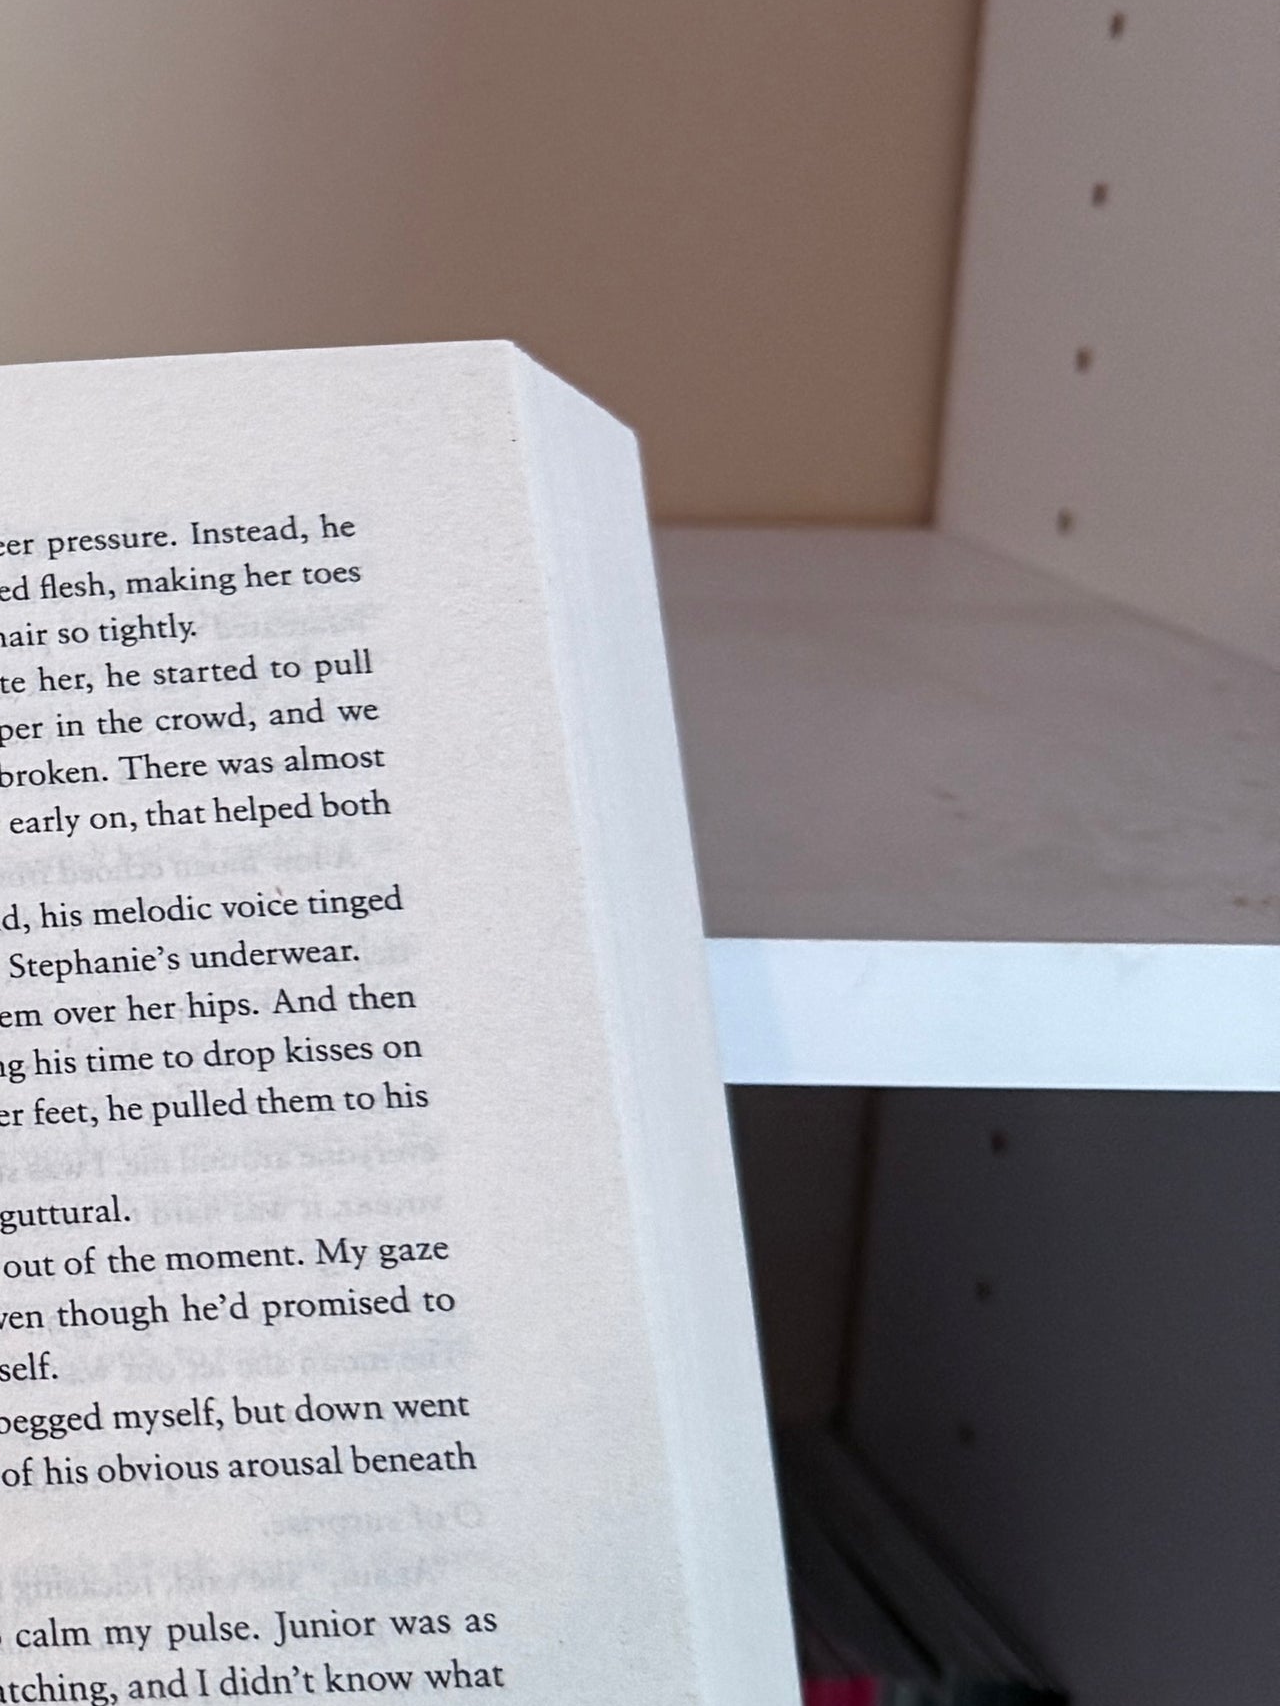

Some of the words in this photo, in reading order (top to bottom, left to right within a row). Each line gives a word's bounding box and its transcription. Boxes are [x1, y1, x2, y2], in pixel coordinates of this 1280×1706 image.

[46, 530, 178, 562] pressure.
[189, 513, 310, 546] Instead,
[318, 512, 357, 540] he
[116, 752, 210, 782] There
[215, 755, 276, 777] was
[282, 743, 387, 774] almost
[2, 1255, 57, 1280] out
[62, 1244, 97, 1277] of
[106, 1243, 158, 1275] the
[163, 1244, 306, 1272] moment.
[314, 1236, 369, 1272] My
[377, 1240, 450, 1271] gaze
[14, 1615, 93, 1650] calm
[103, 1623, 154, 1653] my
[165, 1609, 261, 1653] pulse.
[272, 1607, 378, 1649] Junior
[388, 1613, 453, 1637] was
[463, 1611, 499, 1634] as
